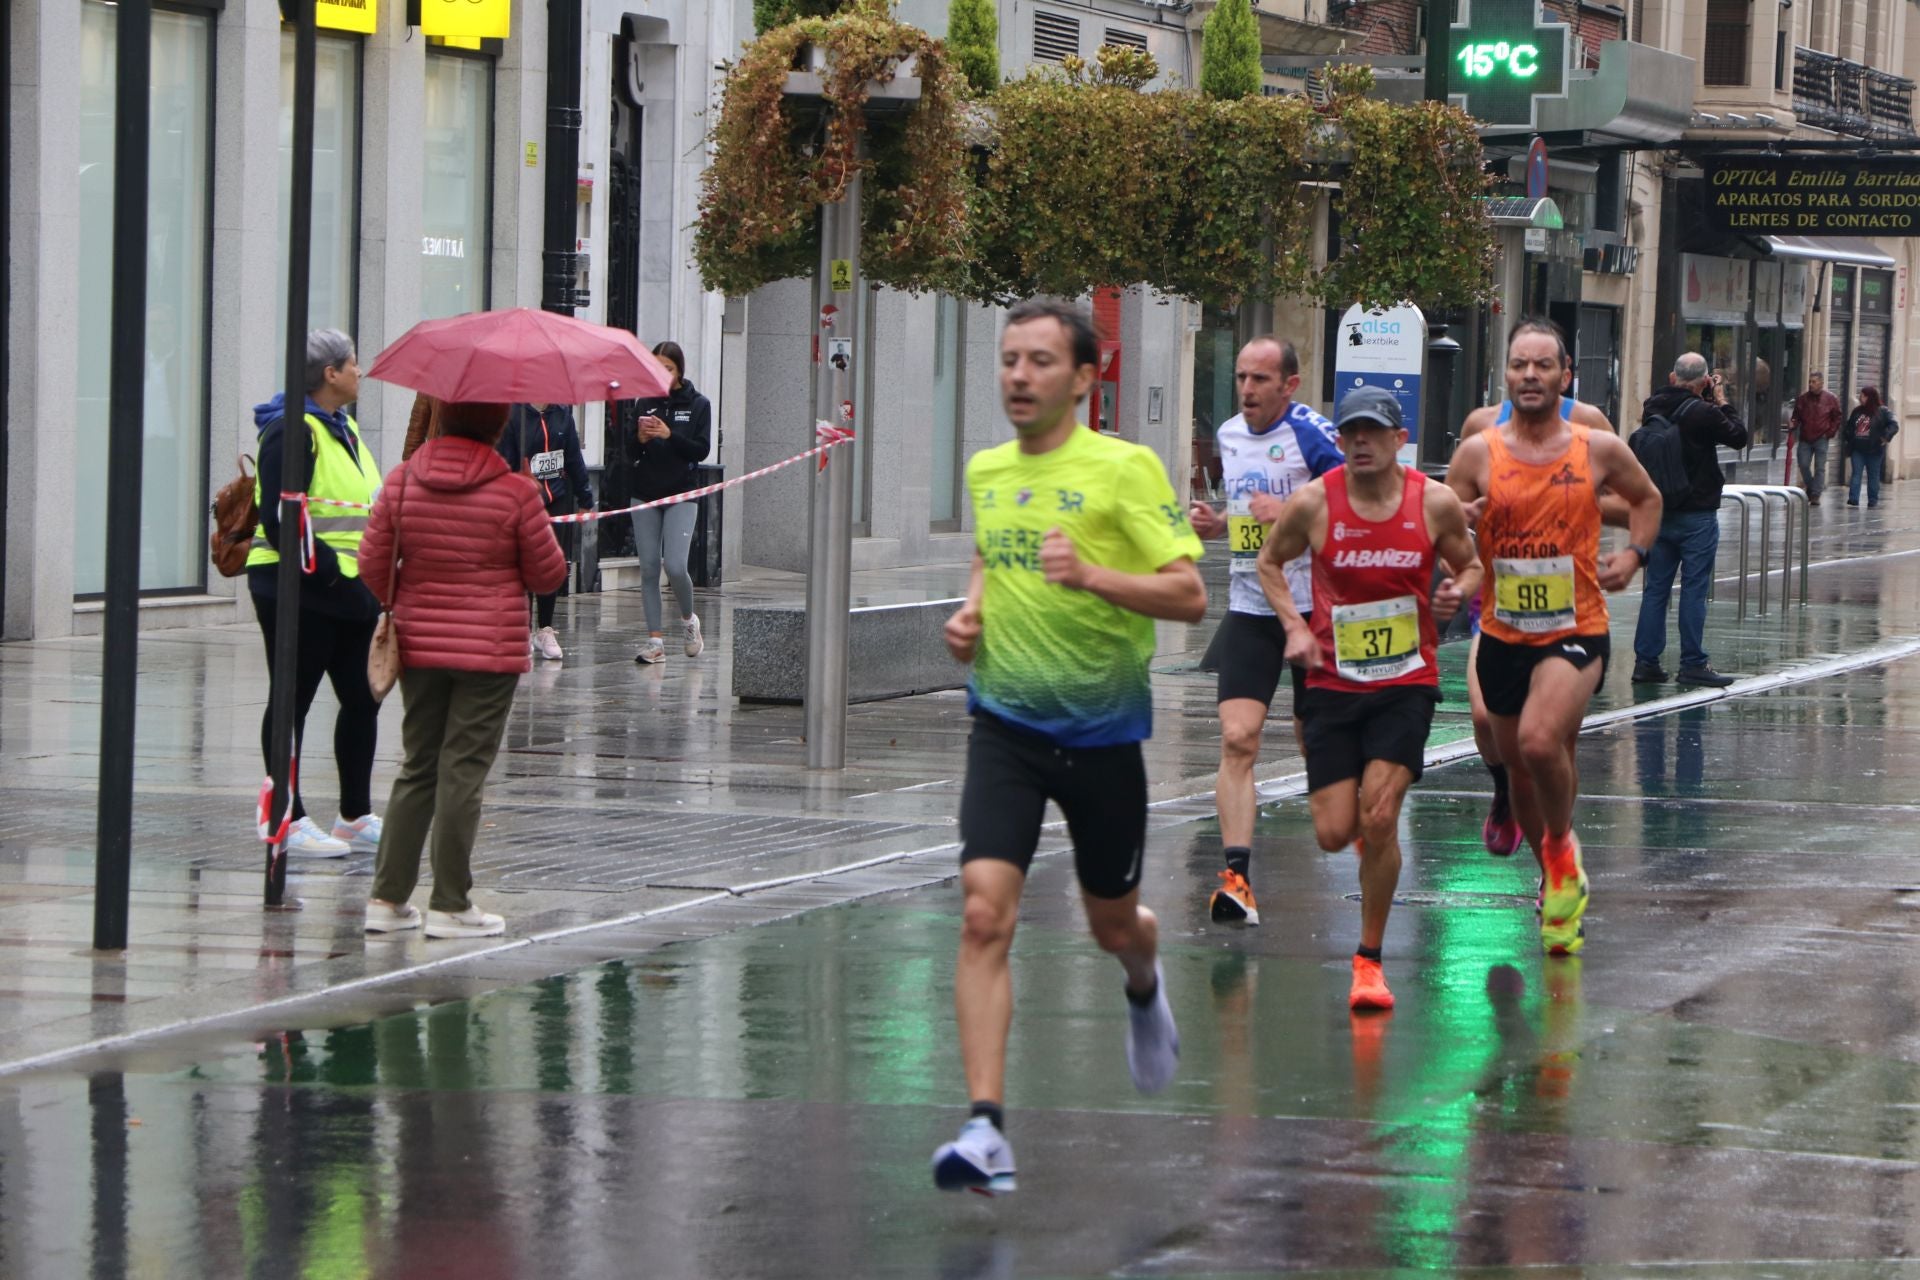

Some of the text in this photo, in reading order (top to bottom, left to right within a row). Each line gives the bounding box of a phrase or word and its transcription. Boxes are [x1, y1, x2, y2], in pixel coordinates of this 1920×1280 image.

[1713, 169, 1777, 186] OPTICA
[1787, 170, 1847, 187] Emilia
[1717, 192, 1802, 207] APARATOS
[1808, 193, 1851, 207] PARA
[1730, 213, 1912, 228] LENTES DE CONTACTO
[1362, 319, 1400, 335] alsa
[539, 458, 558, 471] 2361
[1240, 525, 1263, 550] 33
[1518, 584, 1548, 610] 98
[1363, 627, 1392, 657] 37
